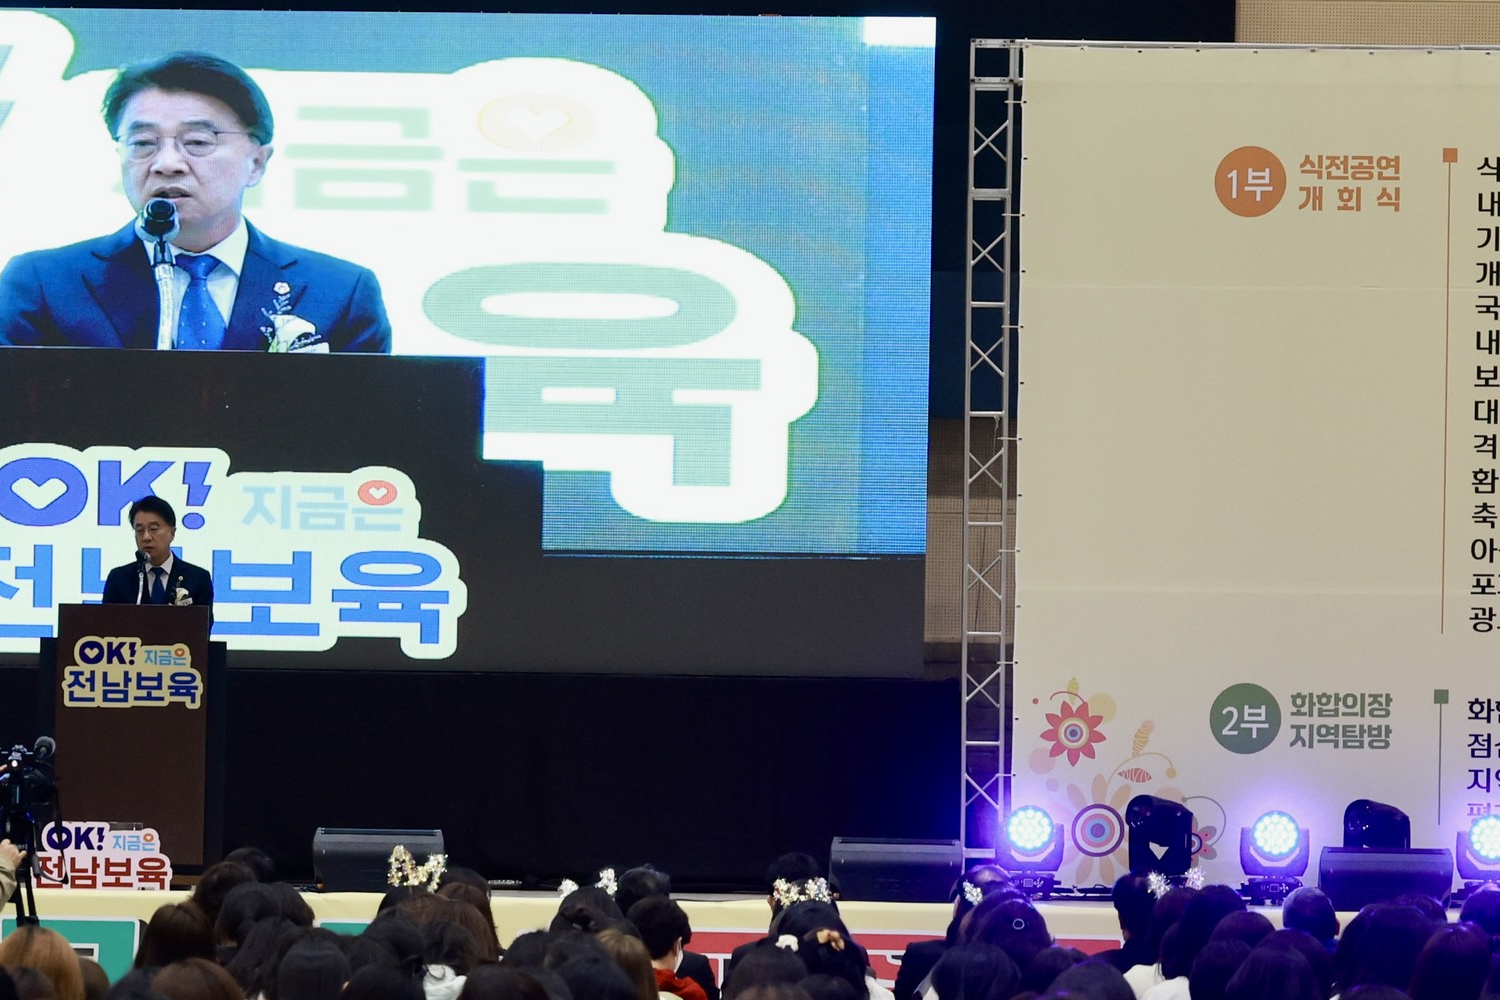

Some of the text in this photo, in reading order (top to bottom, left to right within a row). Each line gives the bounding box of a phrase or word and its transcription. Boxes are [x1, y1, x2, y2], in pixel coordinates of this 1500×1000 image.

[1300, 155, 1400, 180] 식전공연
[1228, 168, 1273, 201] 1부
[241, 479, 404, 533] 지금은
[1471, 538, 1500, 563] 아
[1470, 574, 1500, 595] 포
[1469, 607, 1500, 632] 광
[78, 640, 187, 666] OK! 지금은
[67, 669, 199, 704] 전남보육
[1291, 693, 1392, 718] 화합의장
[1468, 698, 1500, 724] 화
[1222, 705, 1269, 738] 2부
[1290, 724, 1392, 749] 지역탐방
[46, 825, 156, 852] OK! 지금은
